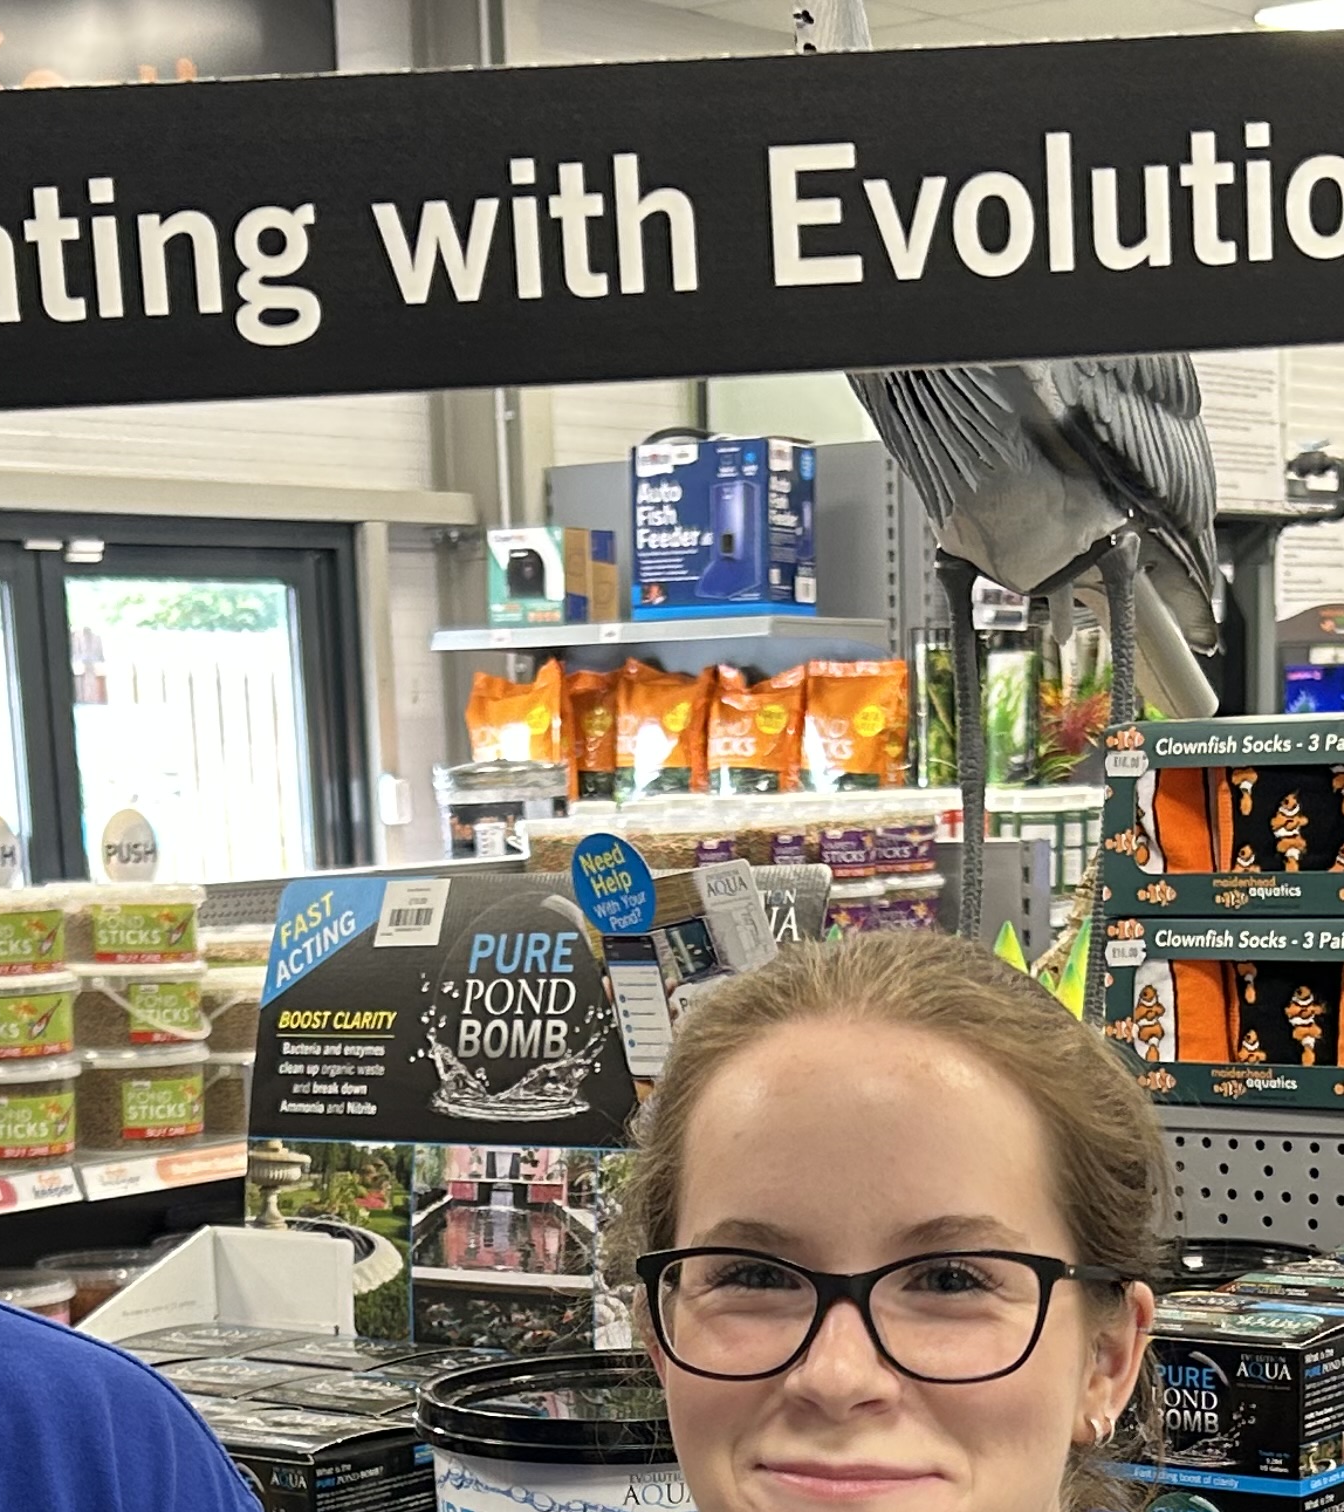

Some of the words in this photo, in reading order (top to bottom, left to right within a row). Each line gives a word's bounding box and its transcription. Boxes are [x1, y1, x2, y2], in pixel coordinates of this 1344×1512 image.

[372, 152, 699, 306] with
[636, 479, 683, 504] Auto
[636, 504, 678, 527] Fish
[636, 528, 701, 550] Feeder
[1155, 734, 1236, 756] Clownfish
[1242, 733, 1292, 754] Socks
[1308, 734, 1320, 752] 3
[105, 841, 158, 865] PUSH
[578, 843, 626, 877] Need
[589, 869, 633, 899] Help
[706, 875, 749, 898] AQUA
[1212, 876, 1277, 889] maidenhead
[1248, 885, 1302, 900] aquatics
[279, 890, 335, 950] FAST
[593, 898, 622, 920] With
[609, 907, 644, 932] Pond?
[97, 930, 162, 946] STICKS
[275, 909, 358, 988] ACTING
[1154, 929, 1235, 950] Clownfish
[1238, 930, 1288, 950] Socks
[1302, 931, 1314, 949] 3
[467, 932, 579, 974] PURE
[461, 978, 577, 1016] POND
[278, 1010, 332, 1029] BOOST
[333, 1010, 397, 1030] CLARITY
[282, 1041, 322, 1055] Bacteria
[323, 1042, 342, 1056] and
[343, 1045, 385, 1058] enzymes
[456, 1018, 570, 1060] BOMB
[279, 1061, 305, 1075] clean
[306, 1064, 320, 1077] up
[321, 1062, 356, 1078] organic
[292, 1082, 311, 1094] and
[312, 1081, 339, 1095] break
[340, 1082, 368, 1095] down
[1245, 1077, 1298, 1091] aquatics
[126, 1103, 186, 1121] STICKS
[279, 1100, 325, 1114] Ammonia
[326, 1101, 345, 1114] and
[346, 1101, 378, 1115] Nitrite
[1236, 1362, 1292, 1383] AQUA
[1152, 1386, 1219, 1411] OND
[270, 1471, 308, 1489] AQUA
[1179, 1473, 1202, 1485] boost
